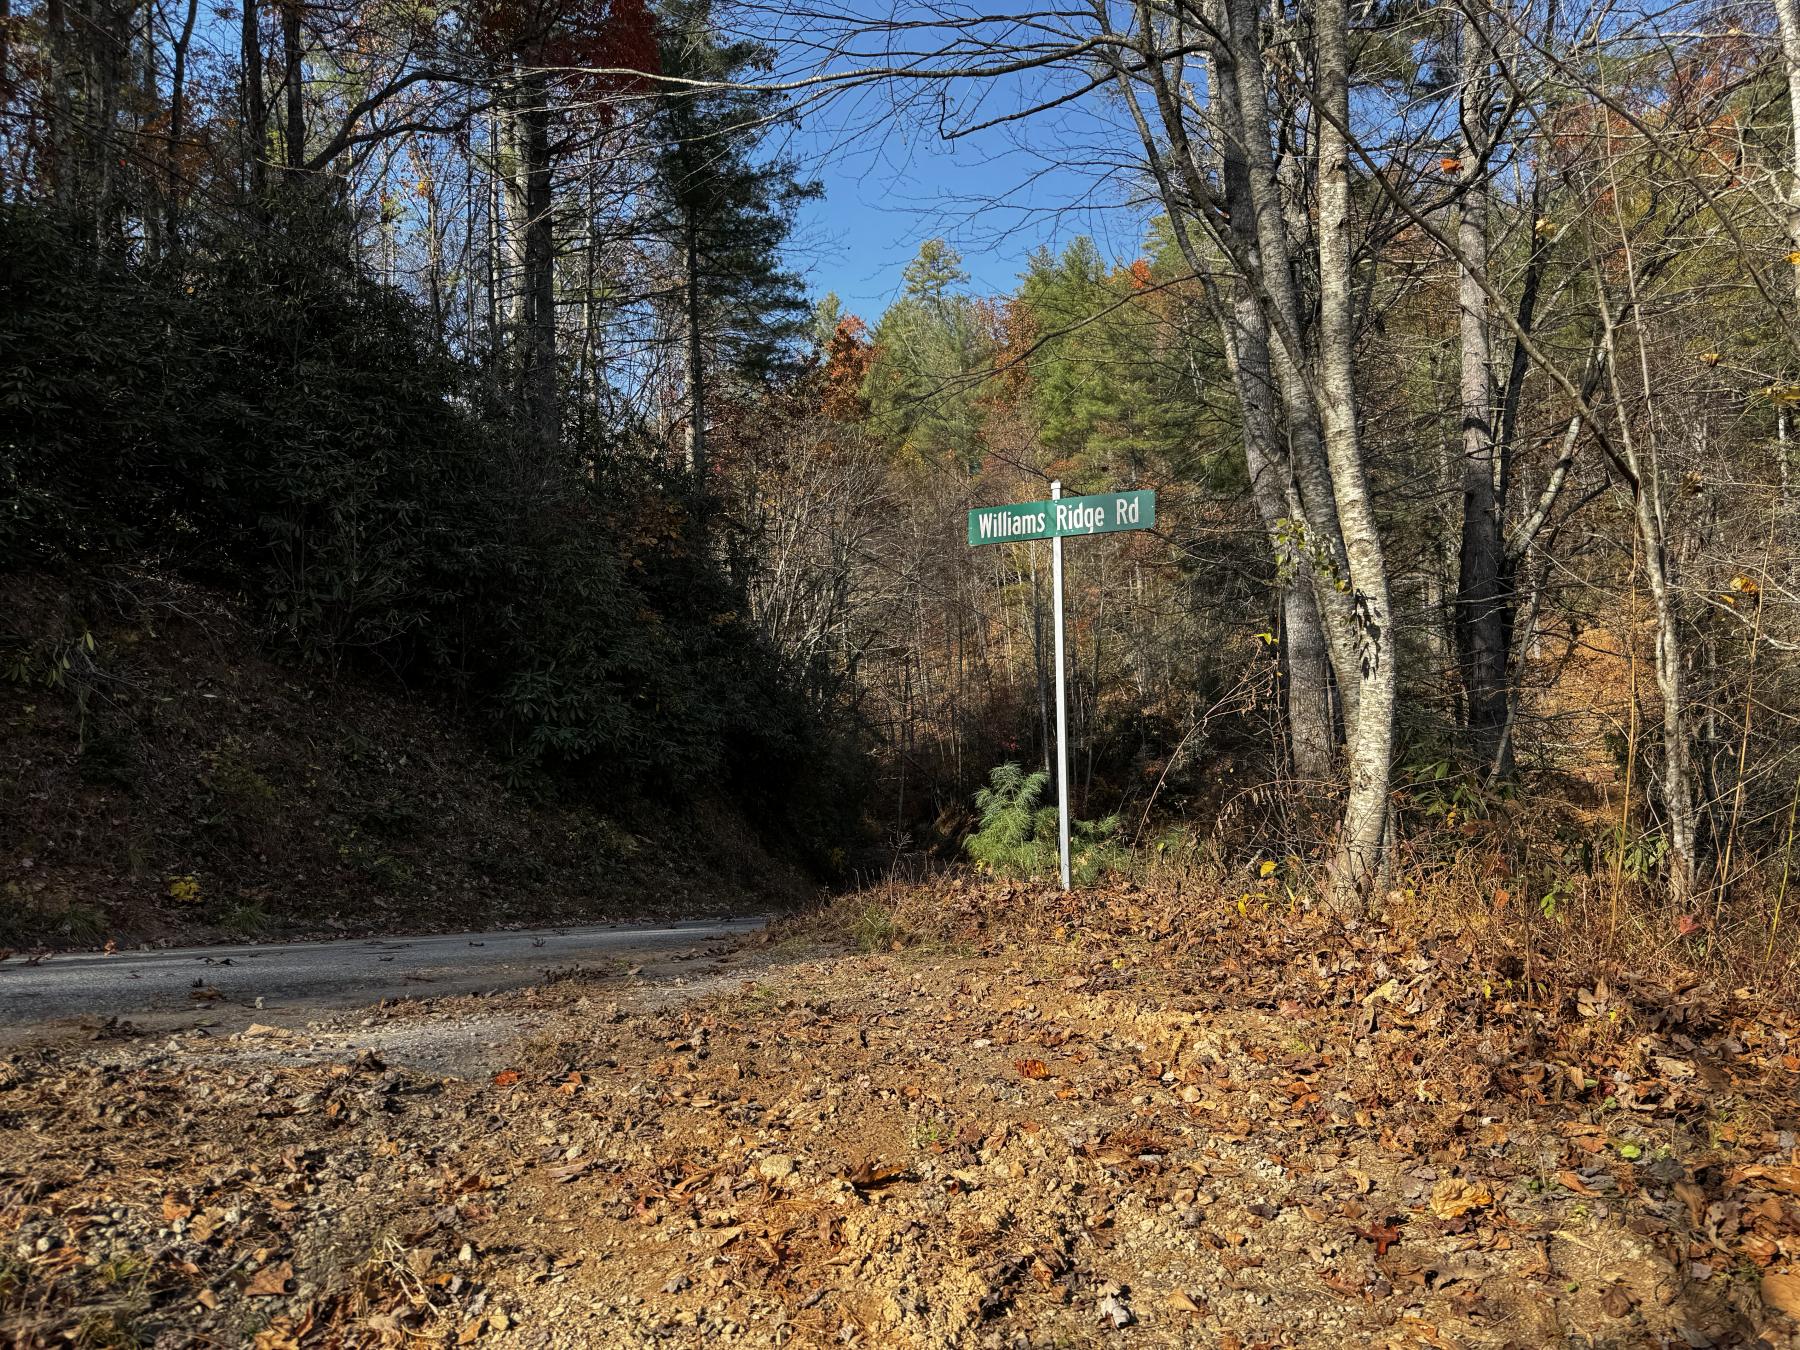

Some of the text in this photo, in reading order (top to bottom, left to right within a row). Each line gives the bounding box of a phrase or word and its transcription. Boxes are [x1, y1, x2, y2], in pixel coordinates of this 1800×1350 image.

[979, 496, 1139, 539] Williams Ridge Rd
